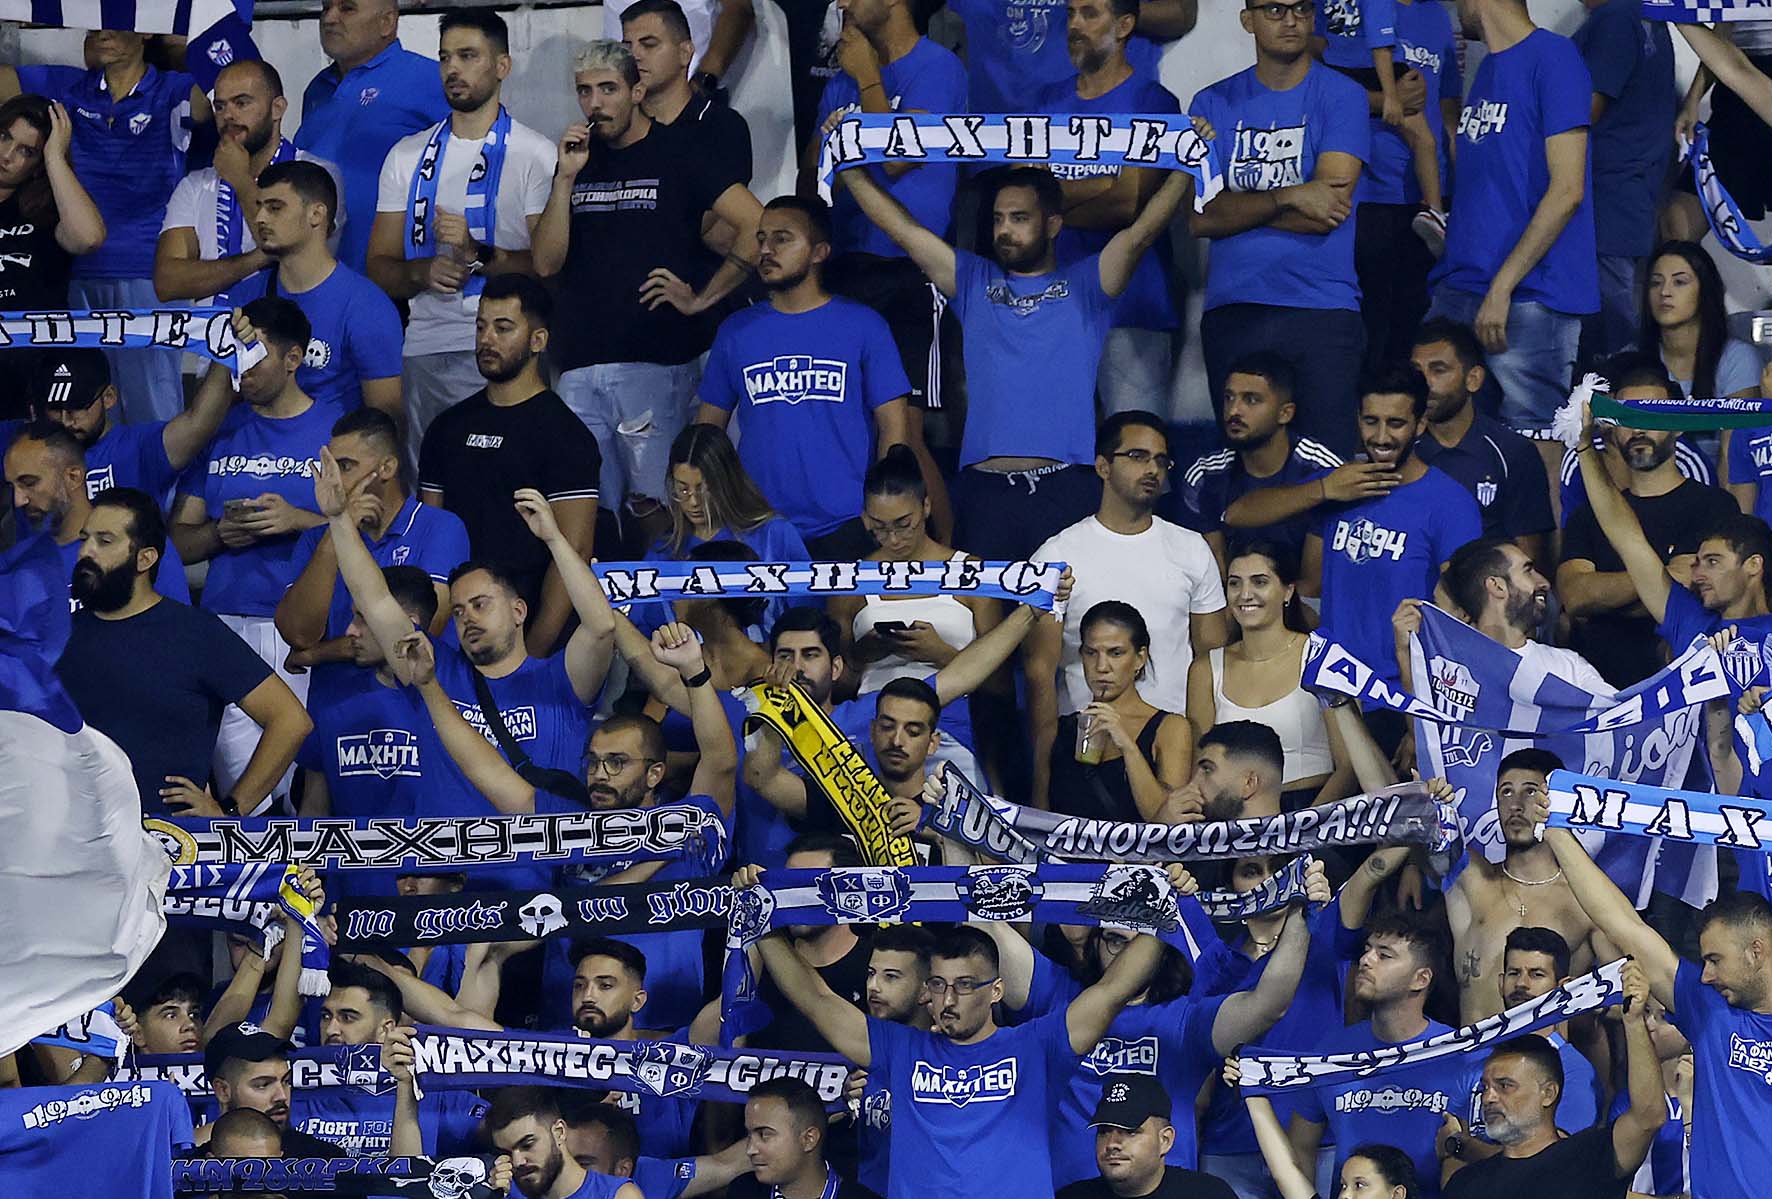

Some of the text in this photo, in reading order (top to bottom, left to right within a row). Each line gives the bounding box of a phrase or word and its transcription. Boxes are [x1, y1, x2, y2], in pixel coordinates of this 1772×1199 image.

[829, 117, 1208, 167] MAXHTEC
[745, 372, 842, 396] MAXHTEC
[606, 560, 1050, 601] MAXHTEC
[211, 803, 704, 869] MAXHTEC
[414, 1036, 617, 1079] MAXHTEC
[914, 1067, 1015, 1098] MAXHTEC
[309, 1119, 359, 1136] FIGHT
